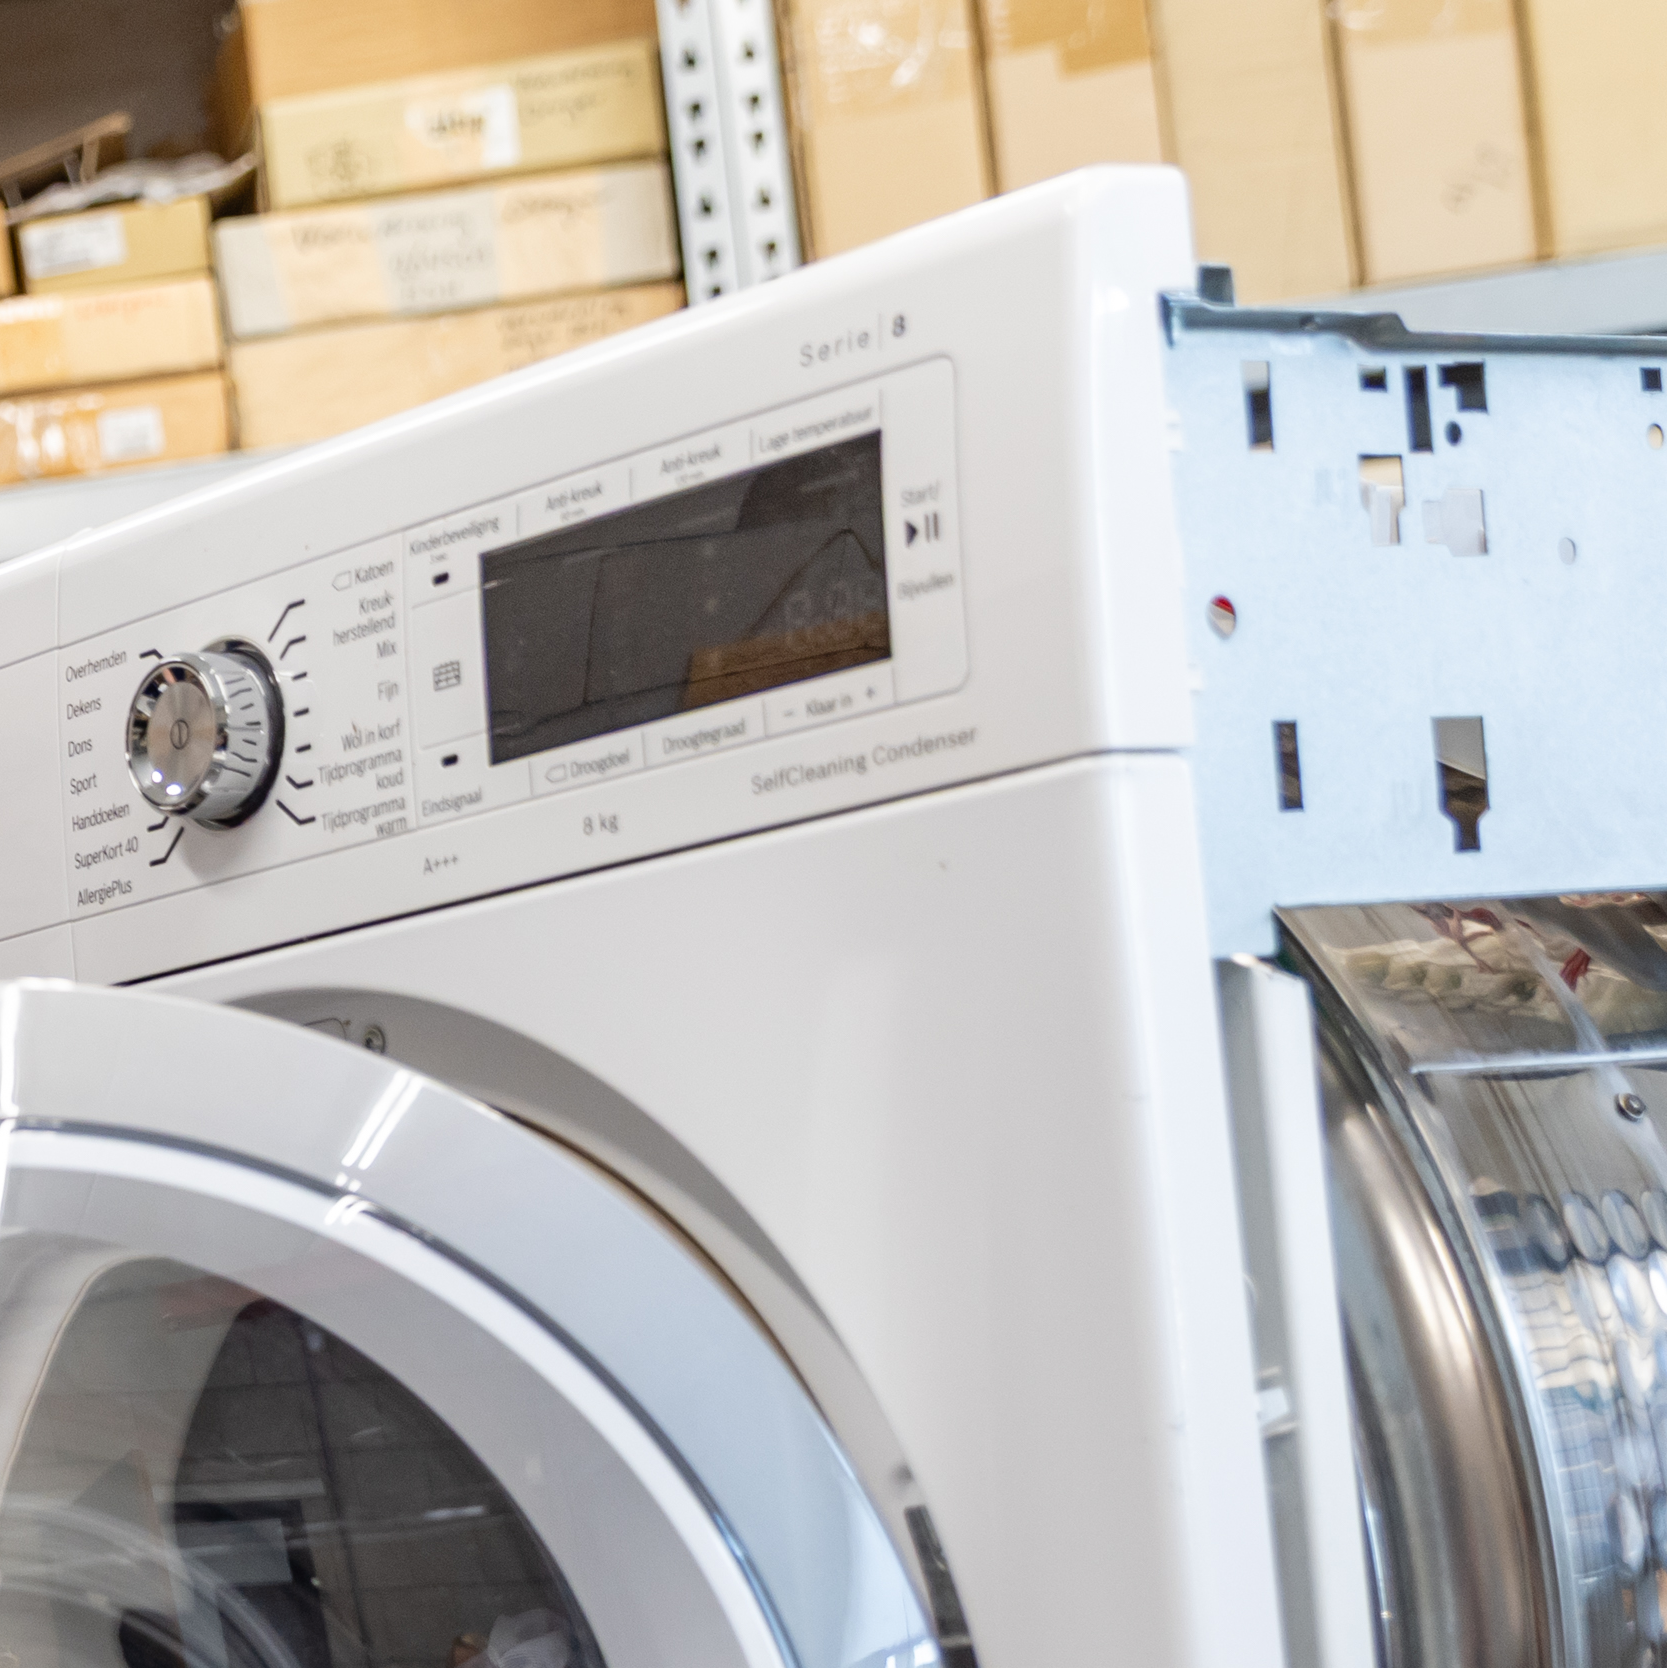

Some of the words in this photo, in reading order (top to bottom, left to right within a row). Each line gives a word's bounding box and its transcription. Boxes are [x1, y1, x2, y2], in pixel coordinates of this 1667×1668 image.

[798, 330, 870, 367] Serie
[892, 314, 907, 338] 8
[409, 517, 500, 556] Kinderbeveiliging
[354, 560, 395, 585] Katoen
[333, 612, 396, 646] herstellend
[376, 639, 397, 660] Mix
[65, 650, 127, 683] Overhemden
[377, 679, 399, 703] Fijn
[66, 697, 102, 720] Dekens
[68, 737, 93, 758] Dons
[341, 727, 363, 752] Wol
[377, 718, 402, 742] korf
[317, 749, 403, 787] Tijdprogramma
[750, 753, 867, 795] SelfCleaning
[871, 726, 978, 767] Condenser
[69, 773, 98, 796] Sport
[376, 767, 405, 791] koud
[321, 796, 406, 833] Tijdprogramma
[421, 786, 483, 818] Eindsignaal
[72, 802, 130, 832] Handdoeken
[375, 815, 408, 838] warm
[583, 816, 594, 836] 8
[599, 812, 620, 835] kg
[74, 840, 124, 870] SuperKort
[124, 835, 139, 855] 40
[423, 854, 459, 876] A+++
[77, 879, 133, 907] AllergiePlus
